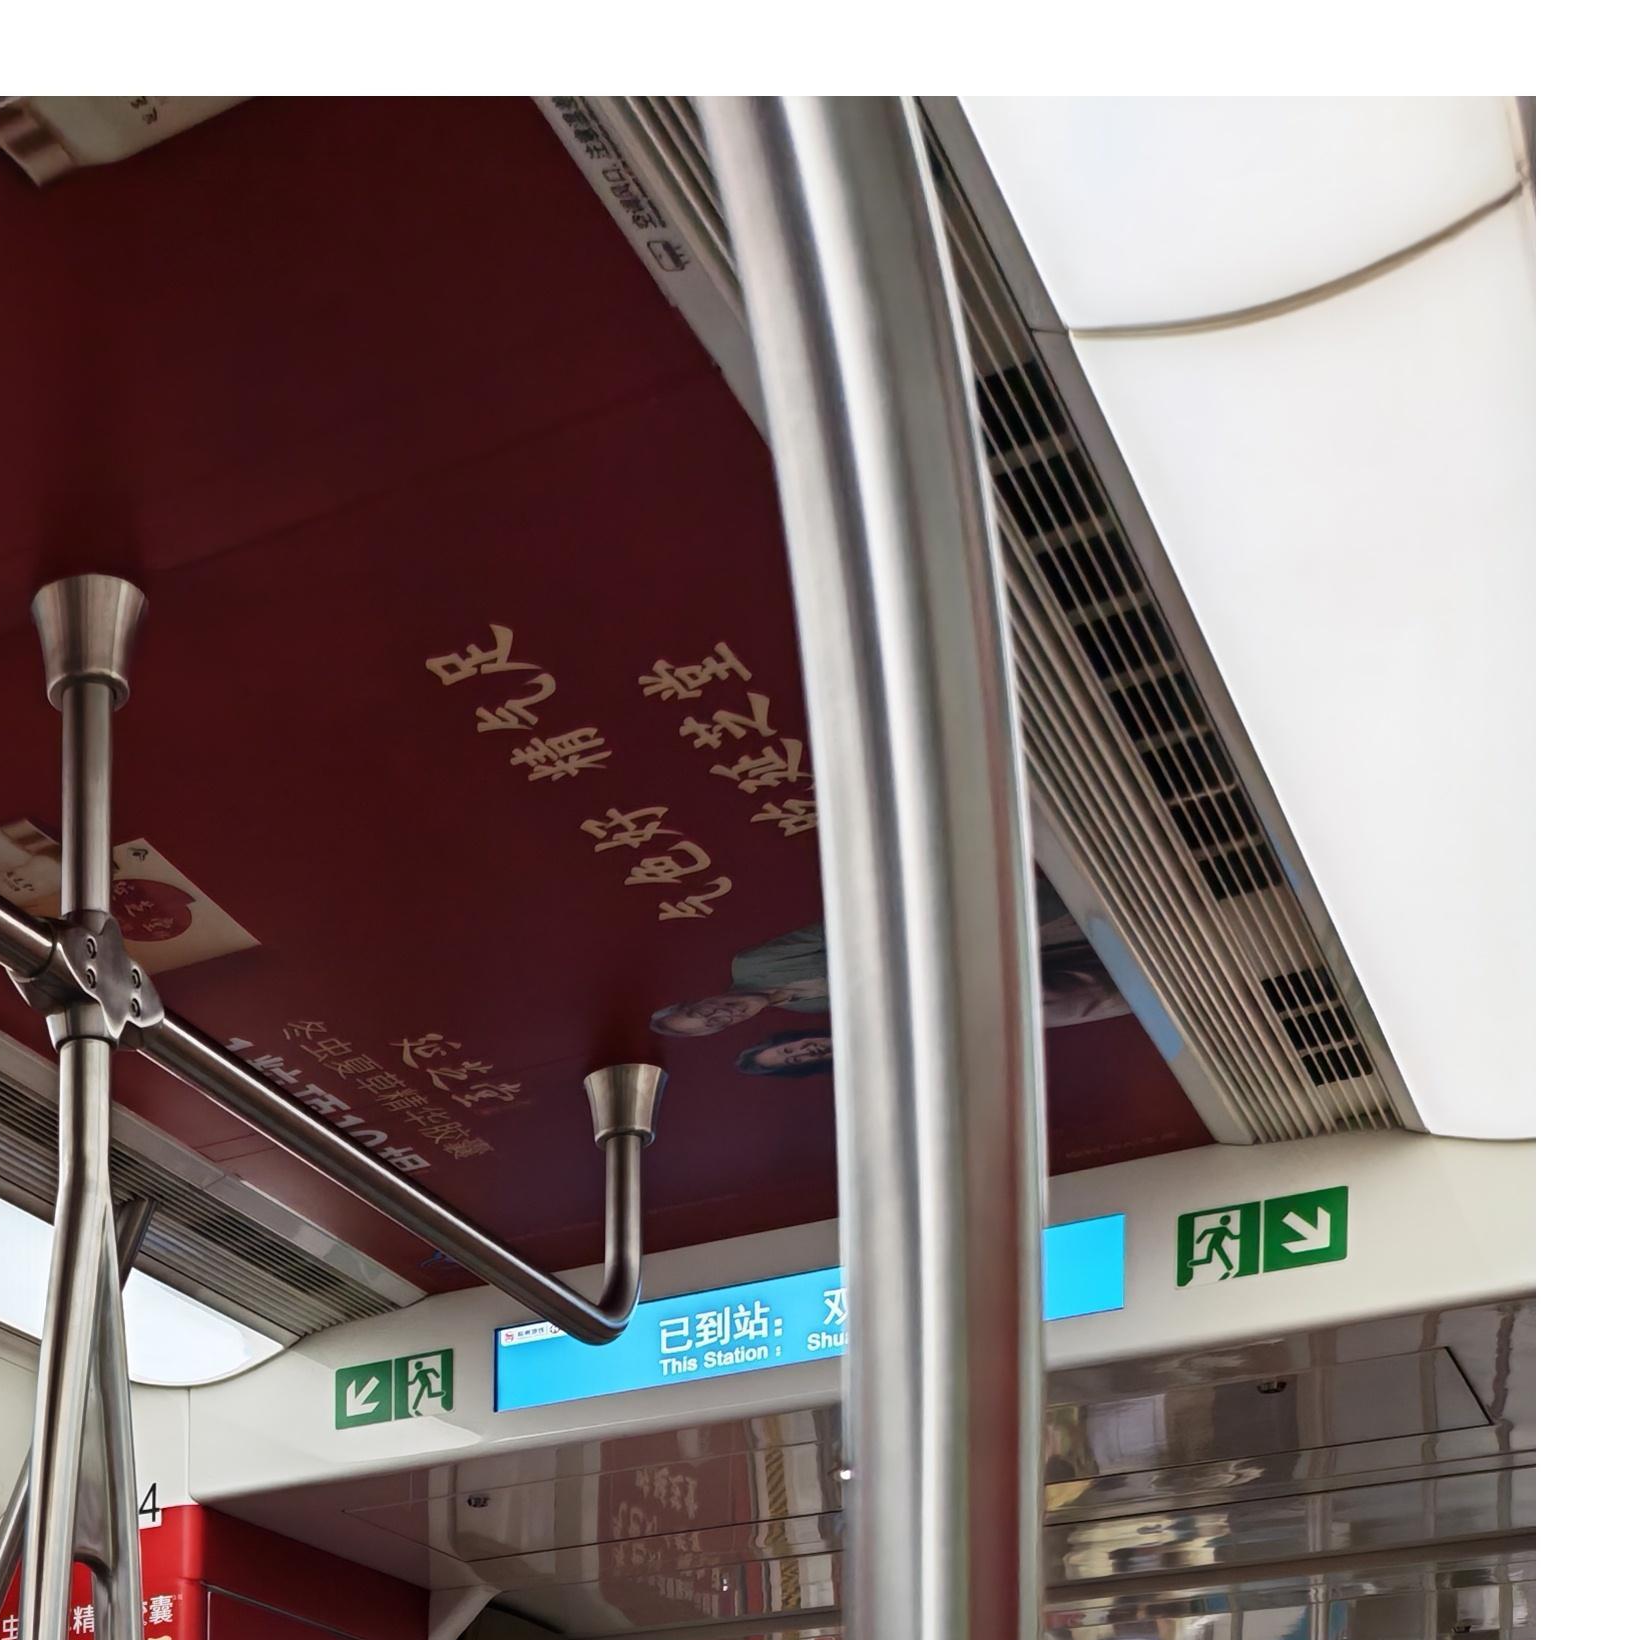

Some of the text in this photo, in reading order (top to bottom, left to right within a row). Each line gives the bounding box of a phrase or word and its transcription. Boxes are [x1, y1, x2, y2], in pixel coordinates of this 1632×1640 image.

[425, 623, 733, 921] 气色好 精气足
[658, 1357, 698, 1377] This
[138, 1482, 161, 1523] 4
